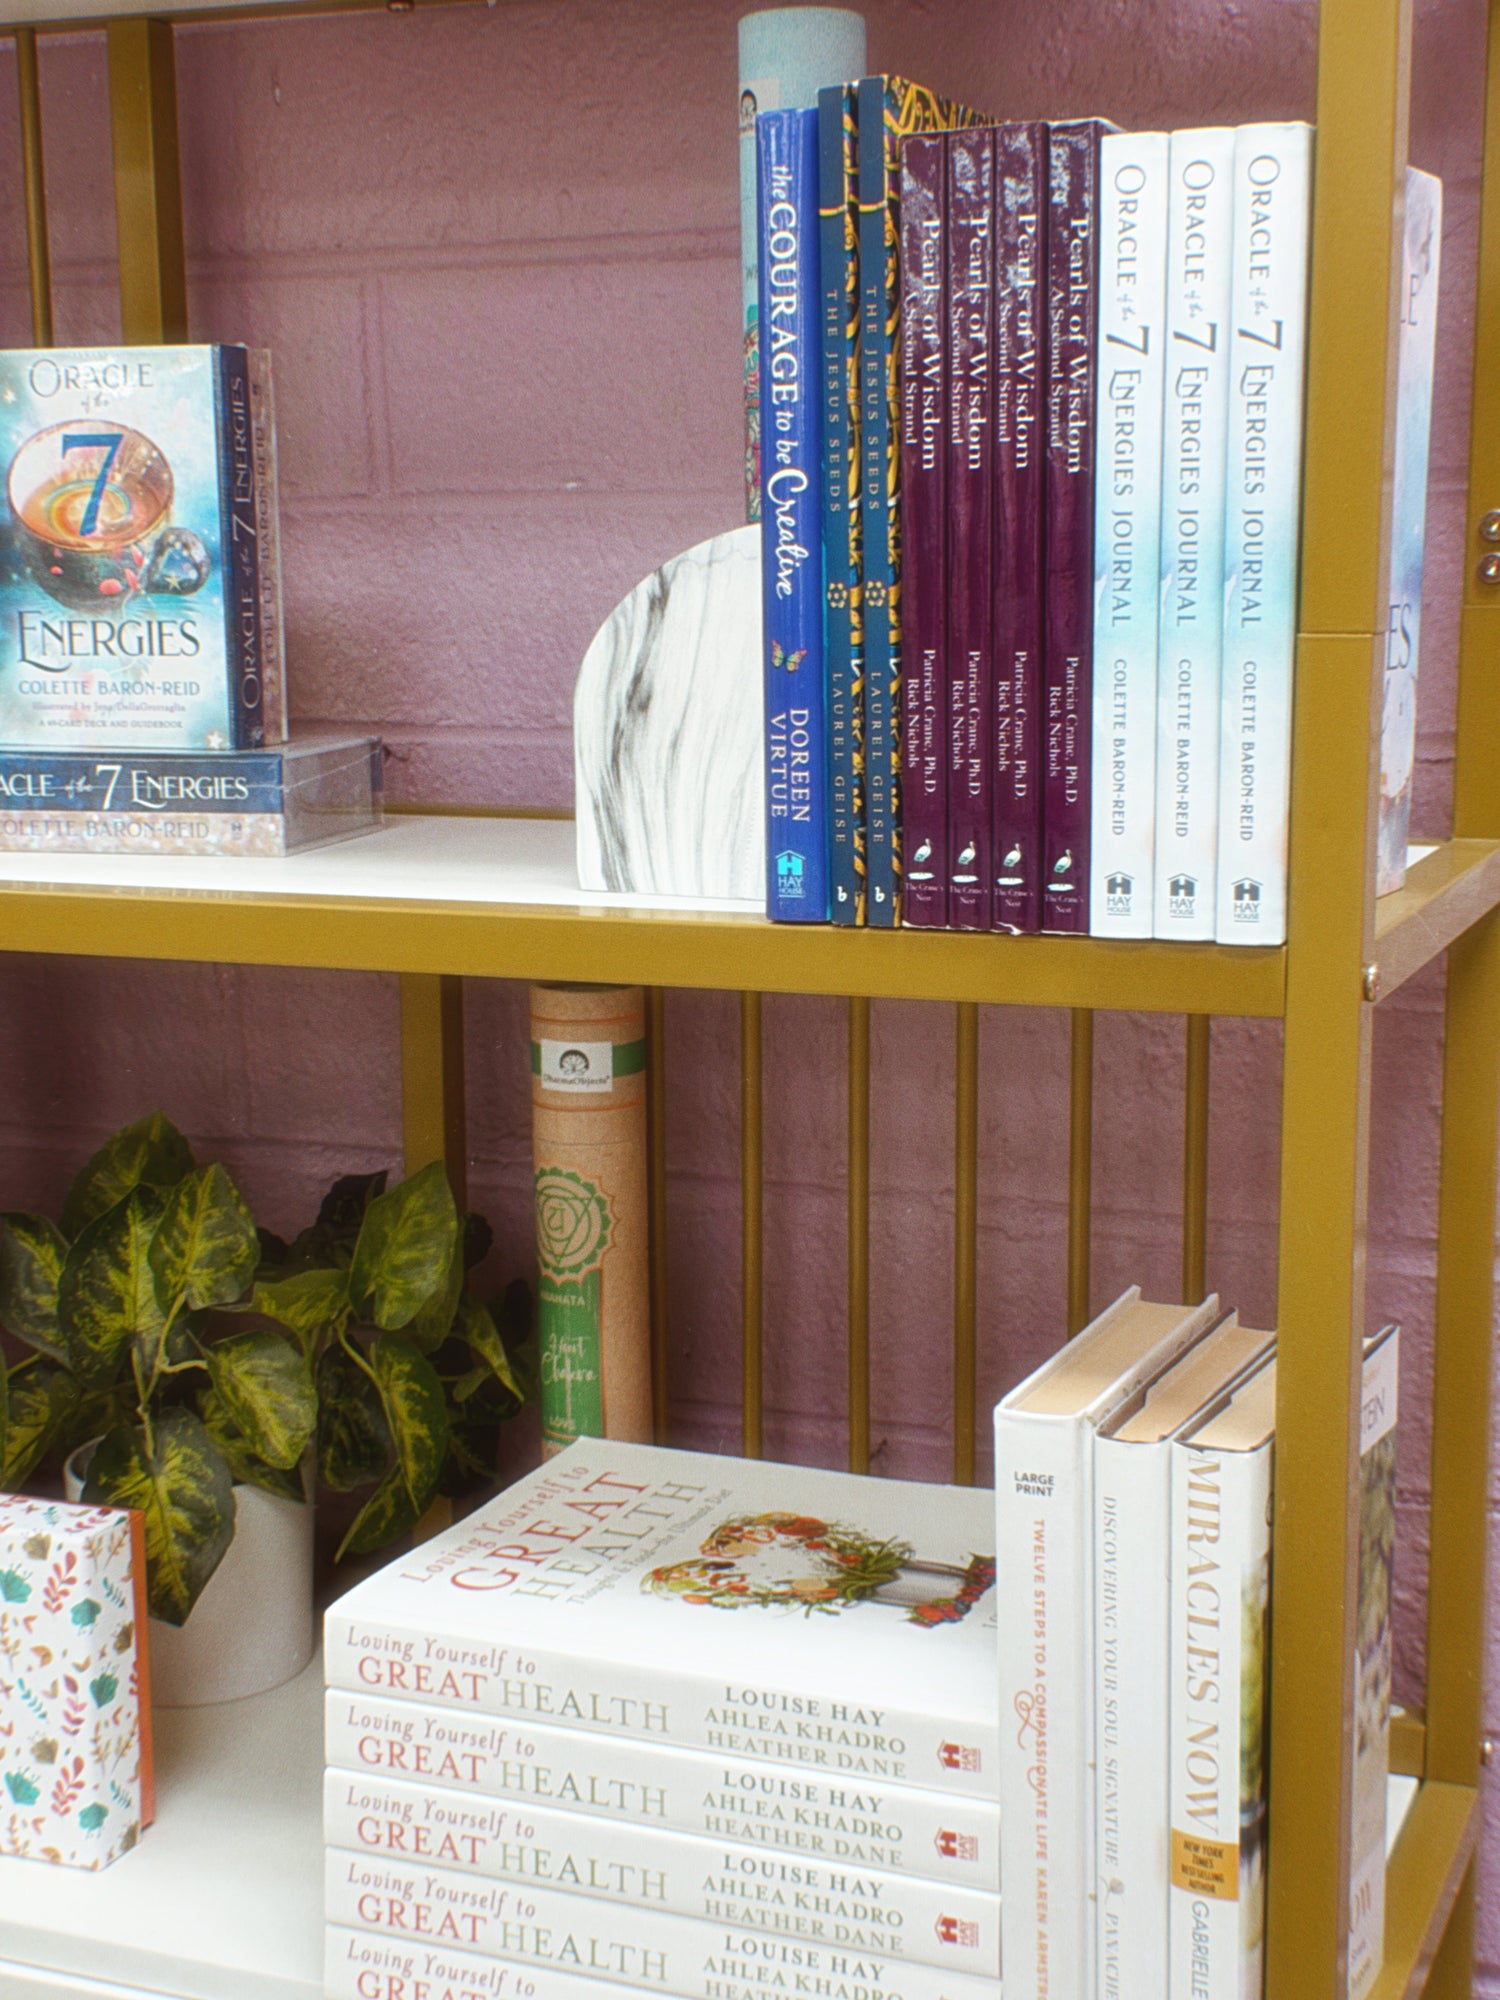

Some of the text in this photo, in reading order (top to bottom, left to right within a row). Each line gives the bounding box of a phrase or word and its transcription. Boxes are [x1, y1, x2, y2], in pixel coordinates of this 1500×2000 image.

[921, 218, 941, 470] Pearls Wisdom
[967, 217, 988, 470] Pearls Wisdom
[1015, 214, 1036, 470] Pearls Wisdom
[1067, 217, 1089, 475] Pearls Wisdom
[29, 358, 154, 398] ORACLE
[766, 163, 810, 601] the COURAGE to be Creative
[826, 290, 841, 513] THE JESUS SEEDS
[865, 286, 880, 511] THE JESUS SEEDS
[904, 308, 918, 445] Second Strand
[950, 307, 965, 445] Second Strand
[998, 304, 1012, 443] Second Strand
[1049, 308, 1065, 449] Second Strand
[1105, 163, 1150, 628] ORACLE 7 ENERGIES JOURNAL
[1172, 159, 1218, 628] ORACLE 7 ENERGIES JOURNAL
[1237, 153, 1284, 629] ORACLE 7 ENERGIES JOURNAL
[61, 433, 124, 537] 7
[231, 376, 261, 710] ORACLE ENERGIES
[17, 610, 201, 673] ENERGIES
[18, 680, 201, 697] COLETTE BARON-REID
[923, 649, 937, 703] Patricia
[968, 650, 982, 704] Patricia
[1014, 650, 1027, 705] Patricia
[1066, 656, 1079, 711] Patricia
[907, 678, 920, 769] Rick Nichols
[952, 716, 965, 771] Nichols
[998, 716, 1011, 772] Nichols
[1049, 722, 1062, 778] Nichols
[1111, 658, 1127, 836] COLETTE BARON-REID
[1175, 658, 1192, 838] COLETTE BARON-REID
[1239, 660, 1257, 842] COLETTE BARON-REID
[770, 712, 788, 819] VIRTUE
[789, 708, 811, 822] DOREEN
[832, 671, 847, 843] LAUREL GEISE
[870, 671, 884, 843] LAUREL GEISE
[0, 764, 249, 811] ACLE 7 ENERGIES
[0, 819, 210, 839] OLETTE BARON-REID
[778, 876, 803, 888] HAY
[1106, 896, 1132, 907] HAY
[1169, 897, 1195, 909] HAY
[1233, 902, 1260, 914] HAY
[1014, 1471, 1055, 1485] LARGE
[1015, 1483, 1053, 1497] PRINT
[400, 1534, 497, 1584] Loving
[450, 1471, 650, 1592] GREAT
[510, 1480, 706, 1602] HEALTH
[1033, 1519, 1046, 1584] TWELVE
[1103, 1495, 1118, 1629] DISCOVERING
[1033, 1590, 1046, 1640] STEPS
[346, 1625, 537, 1677] Loving Yourself to
[1103, 1638, 1118, 1691] YOUR
[1184, 1452, 1222, 1836] MIRACLES NOW
[357, 1655, 671, 1734] GREAT HEALTH
[724, 1685, 887, 1728] LOUISE HAY
[1103, 1697, 1119, 1747] SOUL
[346, 1704, 536, 1758] Loving Yourself to
[703, 1706, 907, 1756] AHLEA KHADRO
[706, 1729, 908, 1780] HEATHER DANE
[357, 1735, 668, 1818] GREAT HEALTH
[722, 1769, 884, 1814] LOUISE HAY
[346, 1786, 536, 1839] Loving Yourself to
[701, 1791, 904, 1842] AHLEA KHADRO
[1104, 1755, 1119, 1867] SIGNATURE
[357, 1814, 668, 1901] GREAT HEALTH
[704, 1812, 904, 1868] HEATHER DANE
[1035, 1825, 1048, 1861] LIFE
[346, 1862, 537, 1919] Loving Yourself to
[702, 1874, 905, 1928] AHLEA KHADRO
[723, 1853, 885, 1900] LOUISE HAY
[1035, 1868, 1048, 1924] KAREN
[357, 1893, 669, 1982] GREAT HEALTH
[704, 1898, 905, 1953] HEATHER DANE
[1191, 1900, 1210, 2000] GABRIELLE
[345, 1938, 508, 1997] Loving Yourself
[702, 1955, 787, 1987] AHLEA
[724, 1934, 886, 1982] LOUISE HAY
